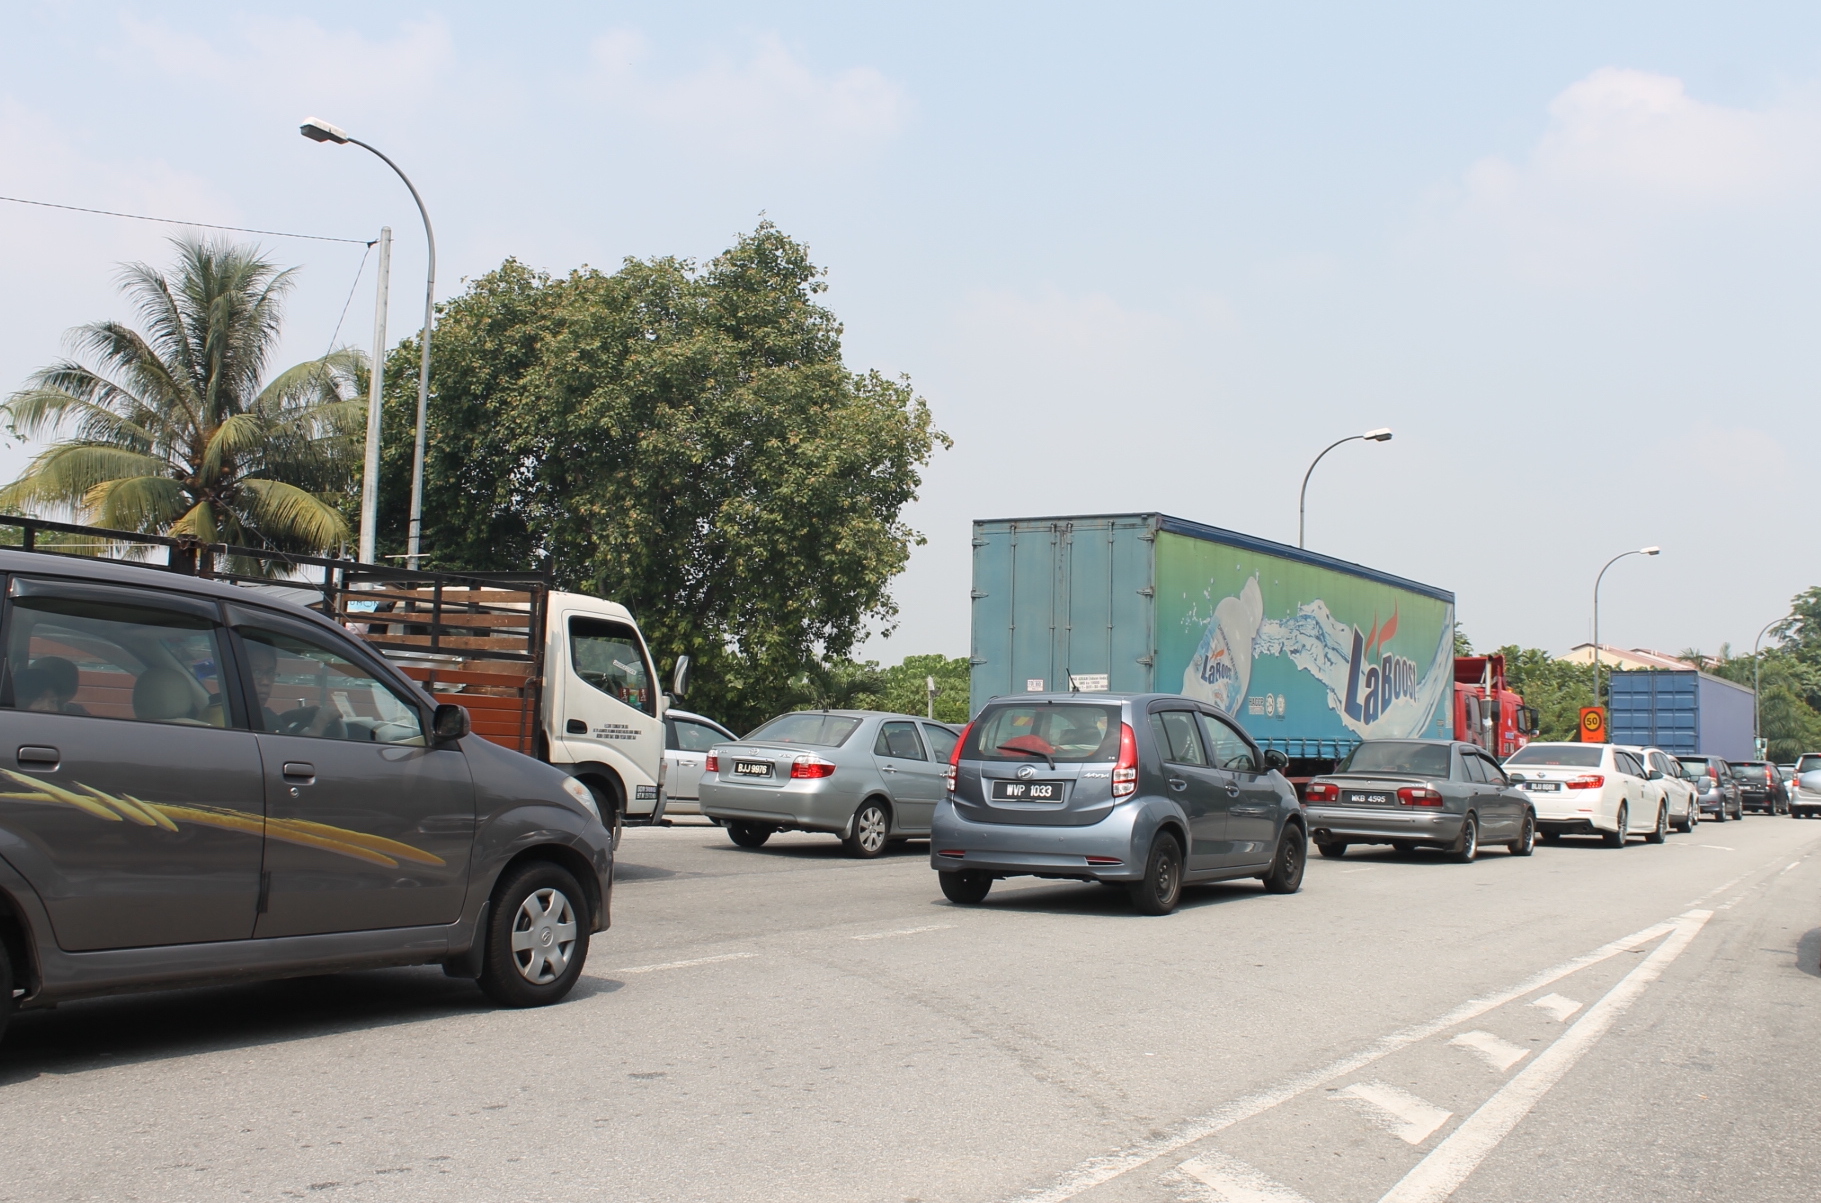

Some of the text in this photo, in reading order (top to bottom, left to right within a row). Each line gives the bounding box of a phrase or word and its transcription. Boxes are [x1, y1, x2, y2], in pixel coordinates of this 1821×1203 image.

[1586, 717, 1597, 726] 50
[738, 763, 767, 774] BJJ 9976
[1006, 784, 1052, 797] WVP 1033
[1367, 795, 1386, 803] 4595
